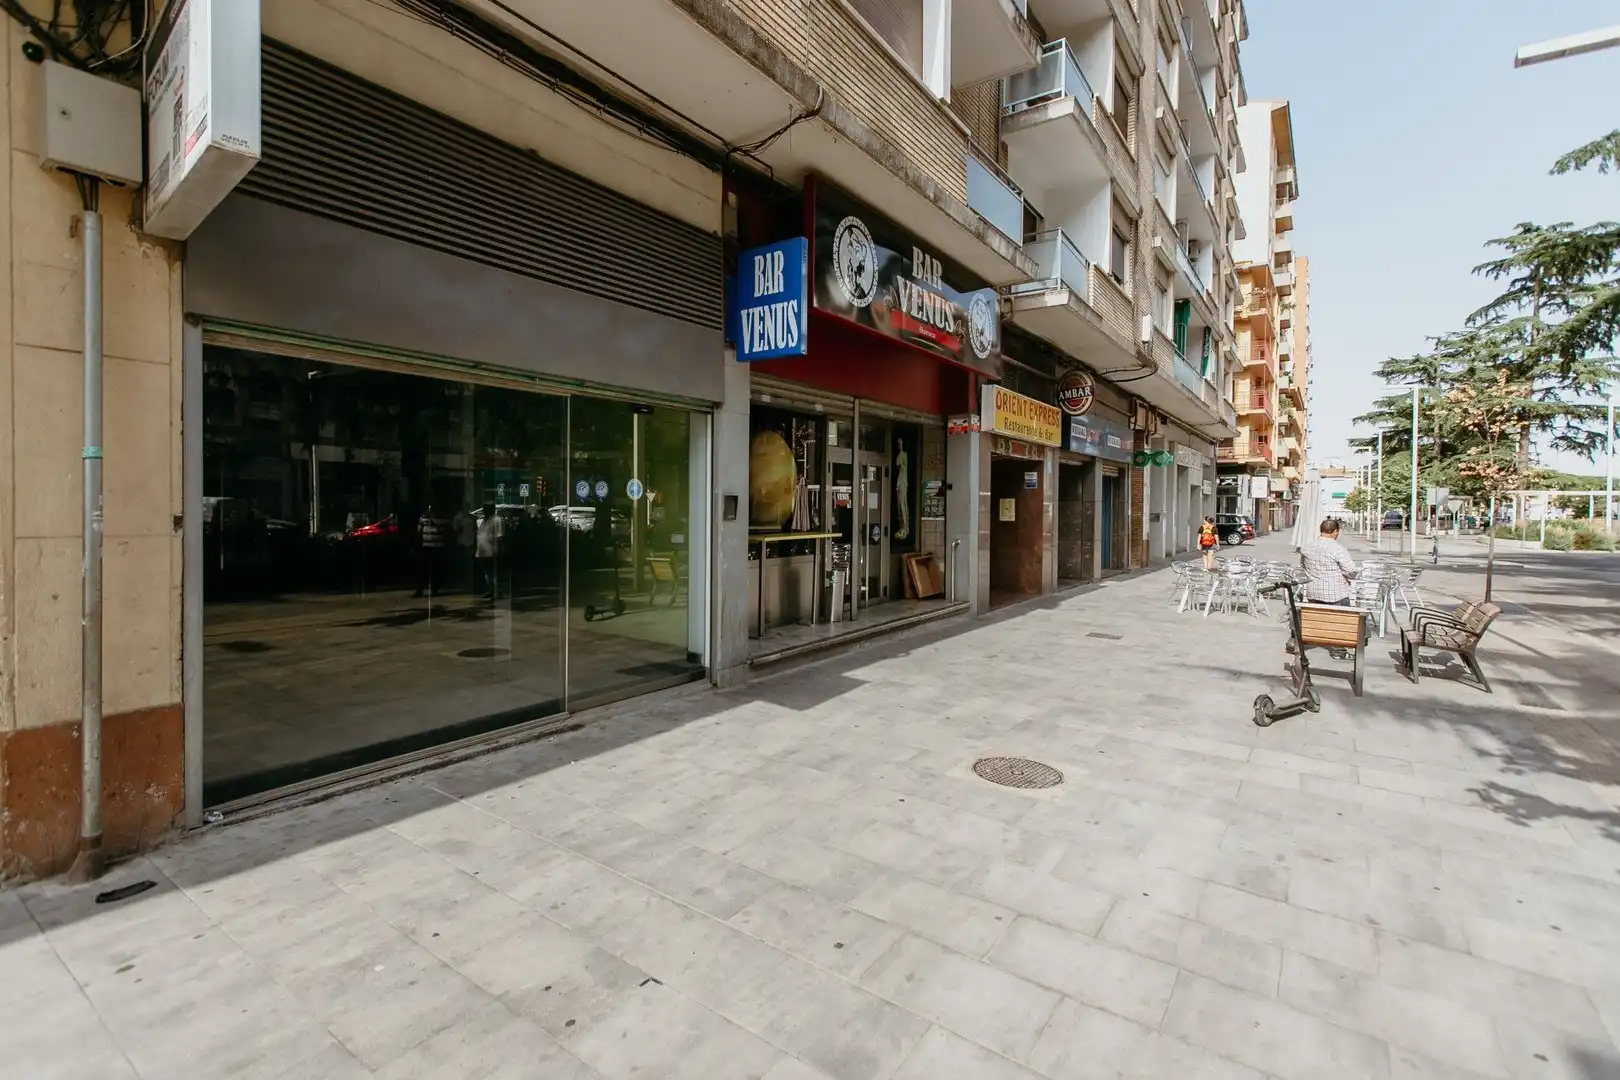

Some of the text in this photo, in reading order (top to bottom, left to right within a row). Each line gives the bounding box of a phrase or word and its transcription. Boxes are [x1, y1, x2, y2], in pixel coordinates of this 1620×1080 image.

[753, 250, 785, 298] BAR
[912, 246, 943, 291] BAR
[740, 299, 798, 354] VENUS
[896, 275, 955, 333] VENUS
[995, 389, 1060, 429] ORIENT EXPRESS
[1058, 386, 1092, 401] AMBAR
[1003, 416, 1037, 438] Restaurante
[1045, 429, 1054, 441] Bar
